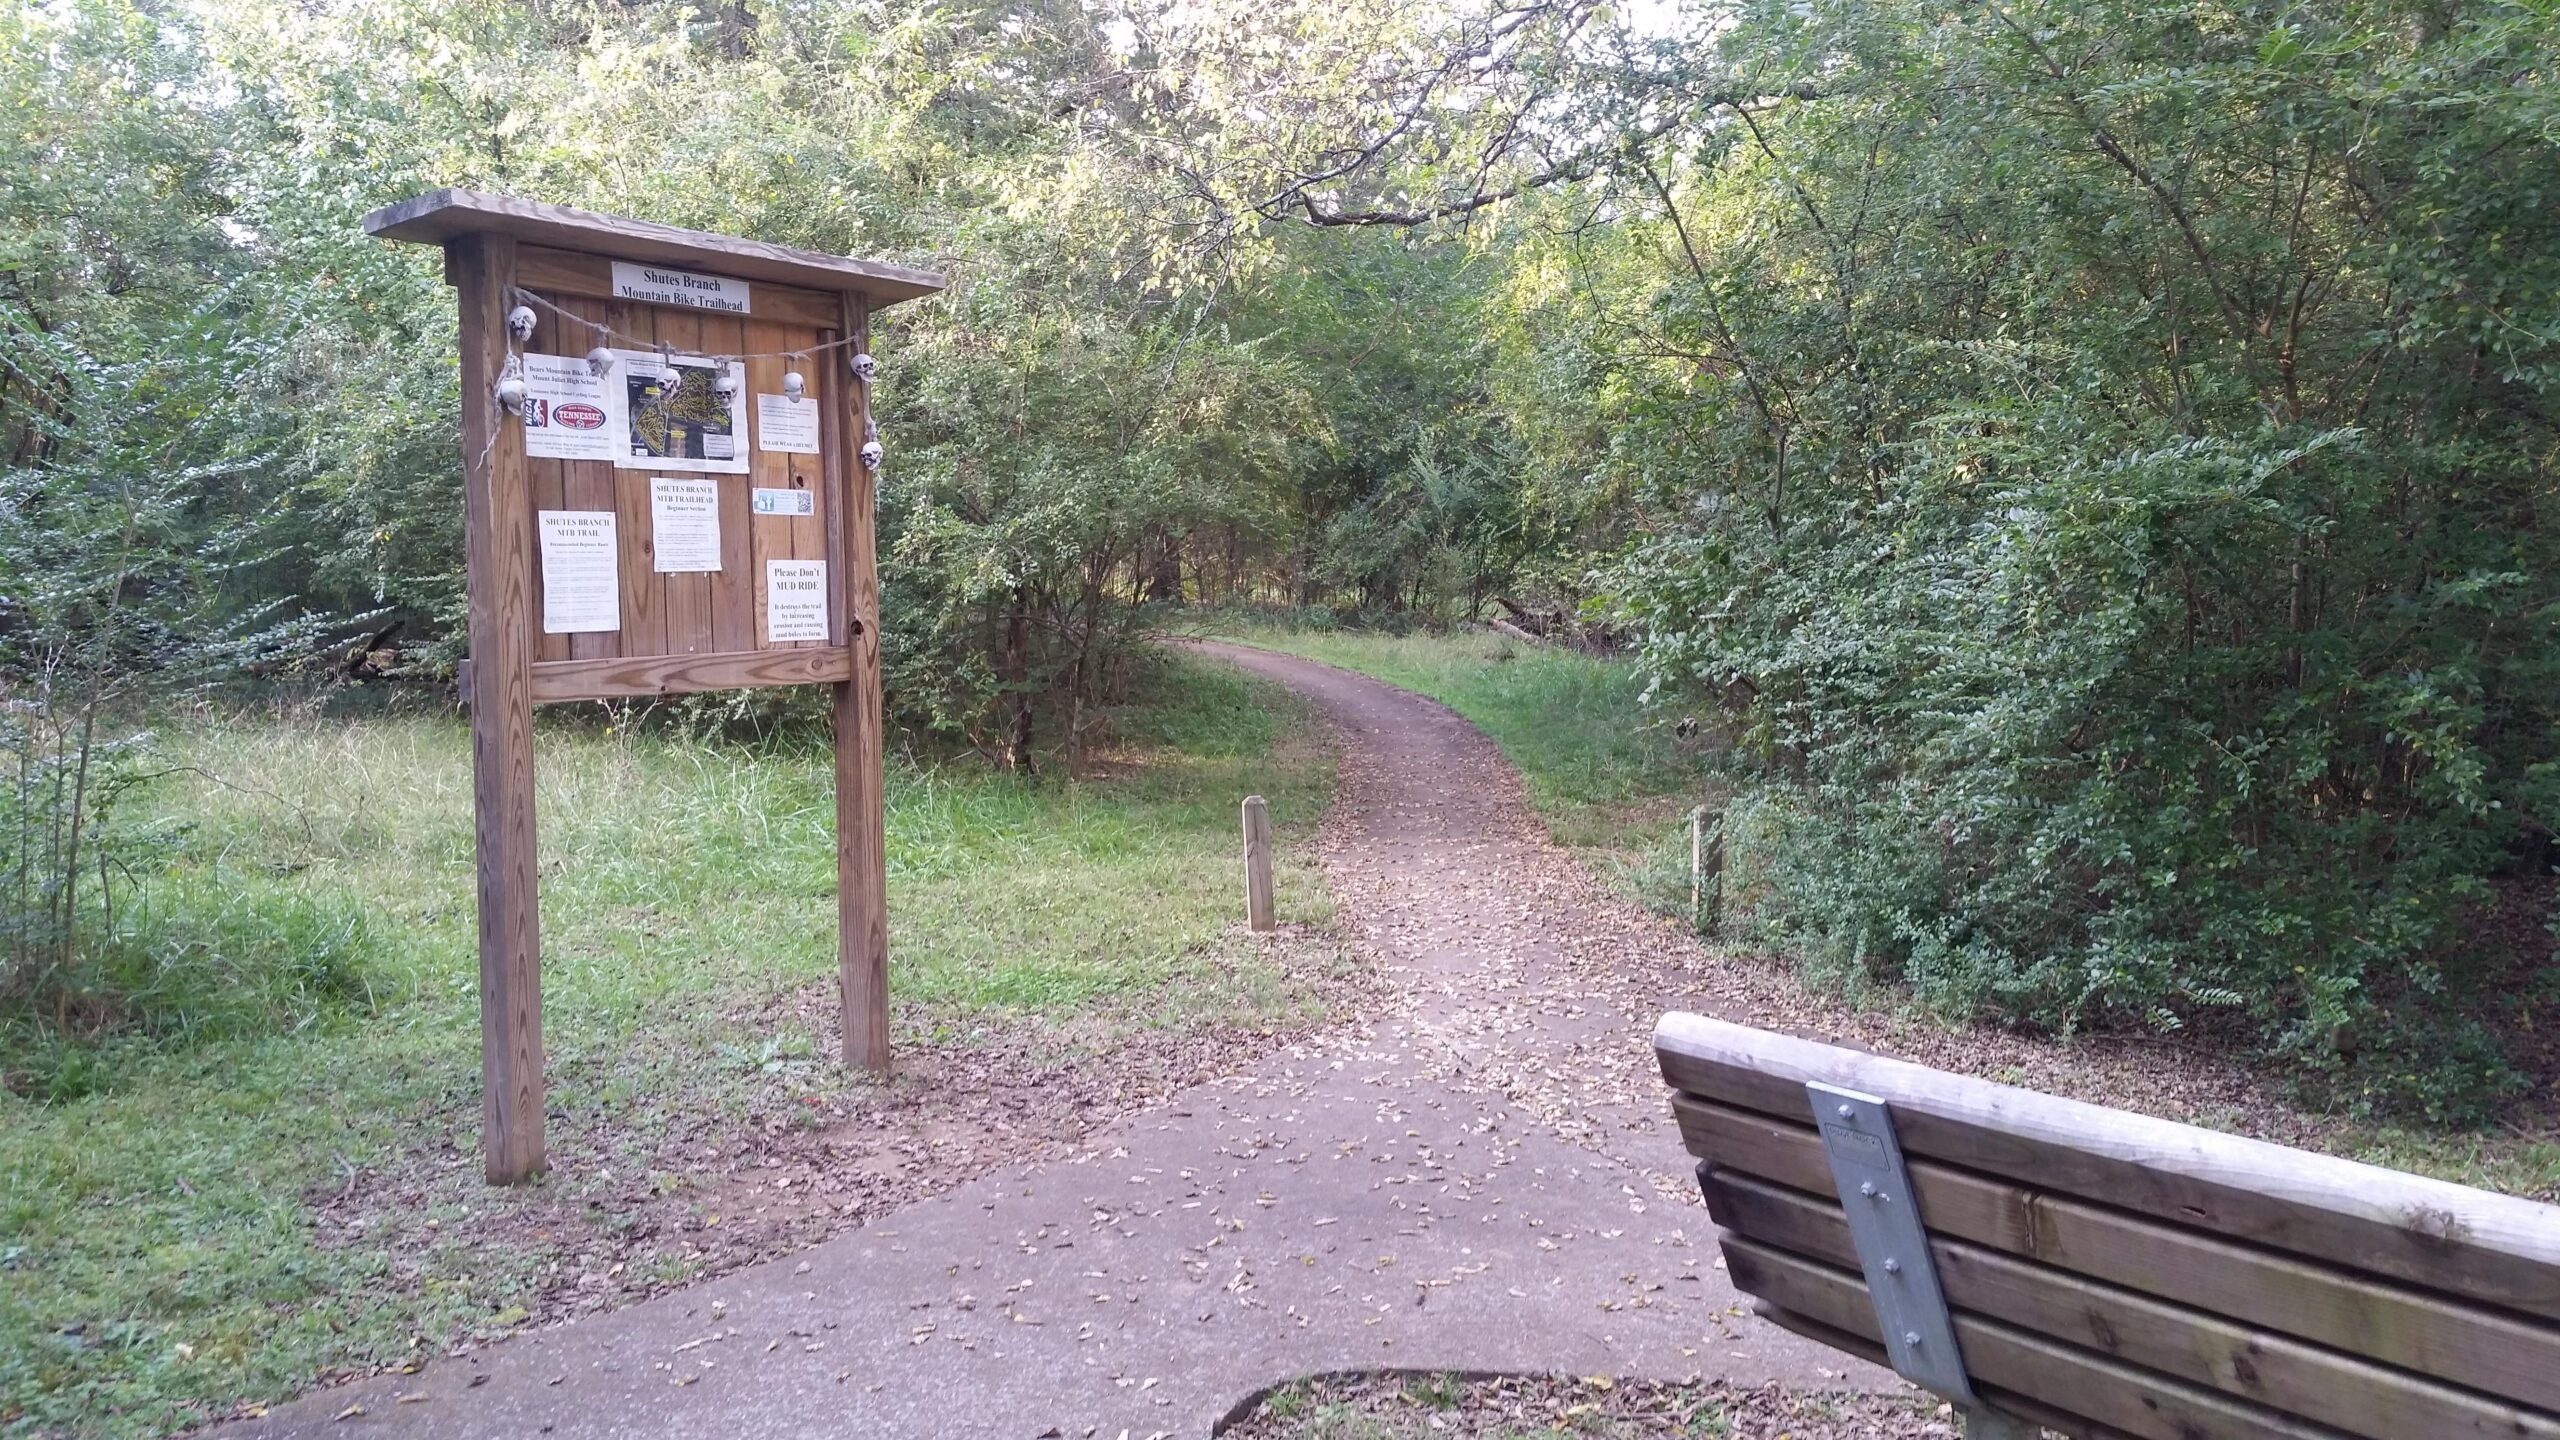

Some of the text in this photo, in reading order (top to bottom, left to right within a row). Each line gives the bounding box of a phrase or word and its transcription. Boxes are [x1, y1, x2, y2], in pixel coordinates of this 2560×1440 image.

[644, 270, 721, 292] Shutes Branch
[622, 286, 743, 311] Mountain Bike Trailhead
[546, 367, 571, 375] Mountain
[532, 374, 550, 382] Mount
[559, 411, 600, 421] TENNESSEE
[656, 485, 713, 494] SHUTES BRANCH
[675, 495, 713, 503] TRAILHEAD
[578, 519, 610, 527] BRANCH
[577, 529, 600, 537] TRAIL
[774, 568, 820, 577] Please Don't
[776, 581, 819, 590] MUD RIDE
[780, 603, 801, 611] destroys
